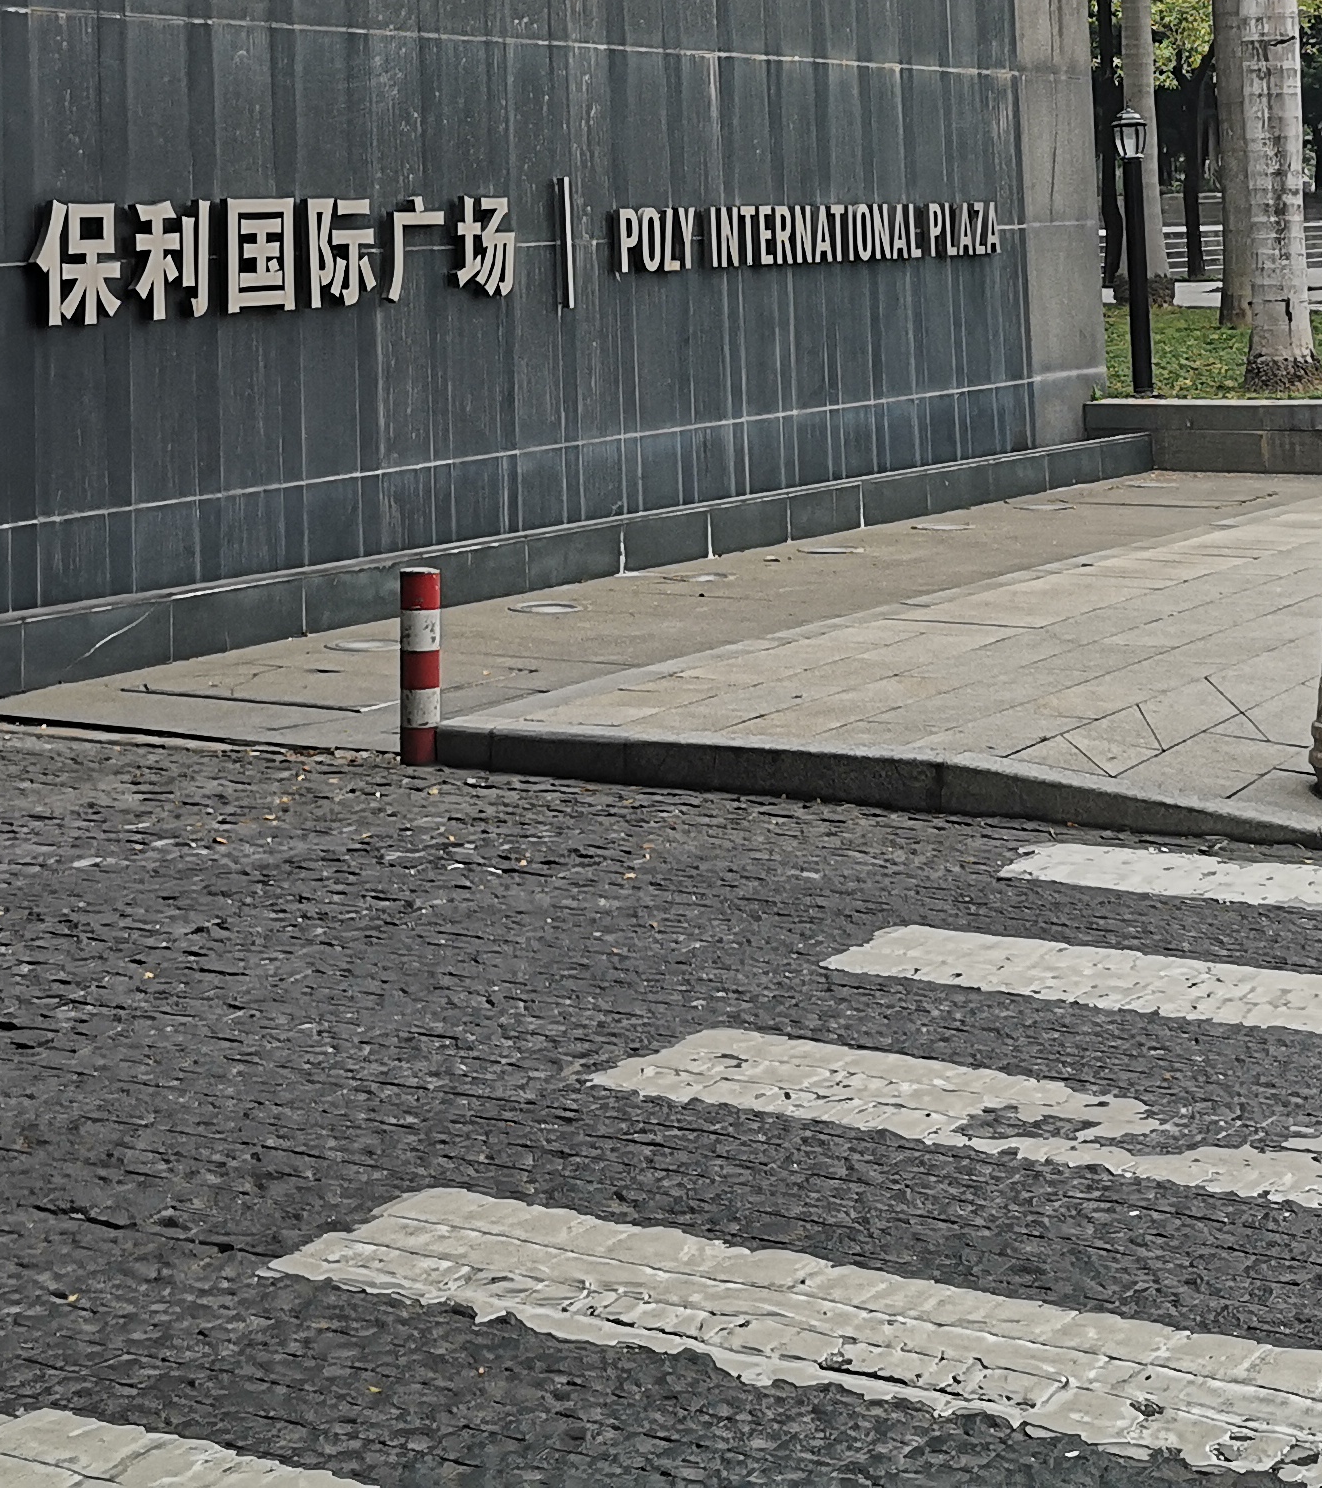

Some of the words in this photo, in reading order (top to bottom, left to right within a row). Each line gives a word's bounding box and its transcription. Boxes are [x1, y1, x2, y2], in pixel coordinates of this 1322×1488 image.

[32, 195, 515, 326] 保利国际广场
[619, 207, 694, 273] POLY
[710, 204, 922, 268] INTERNATIONAL
[929, 202, 1001, 257] PLAZA
